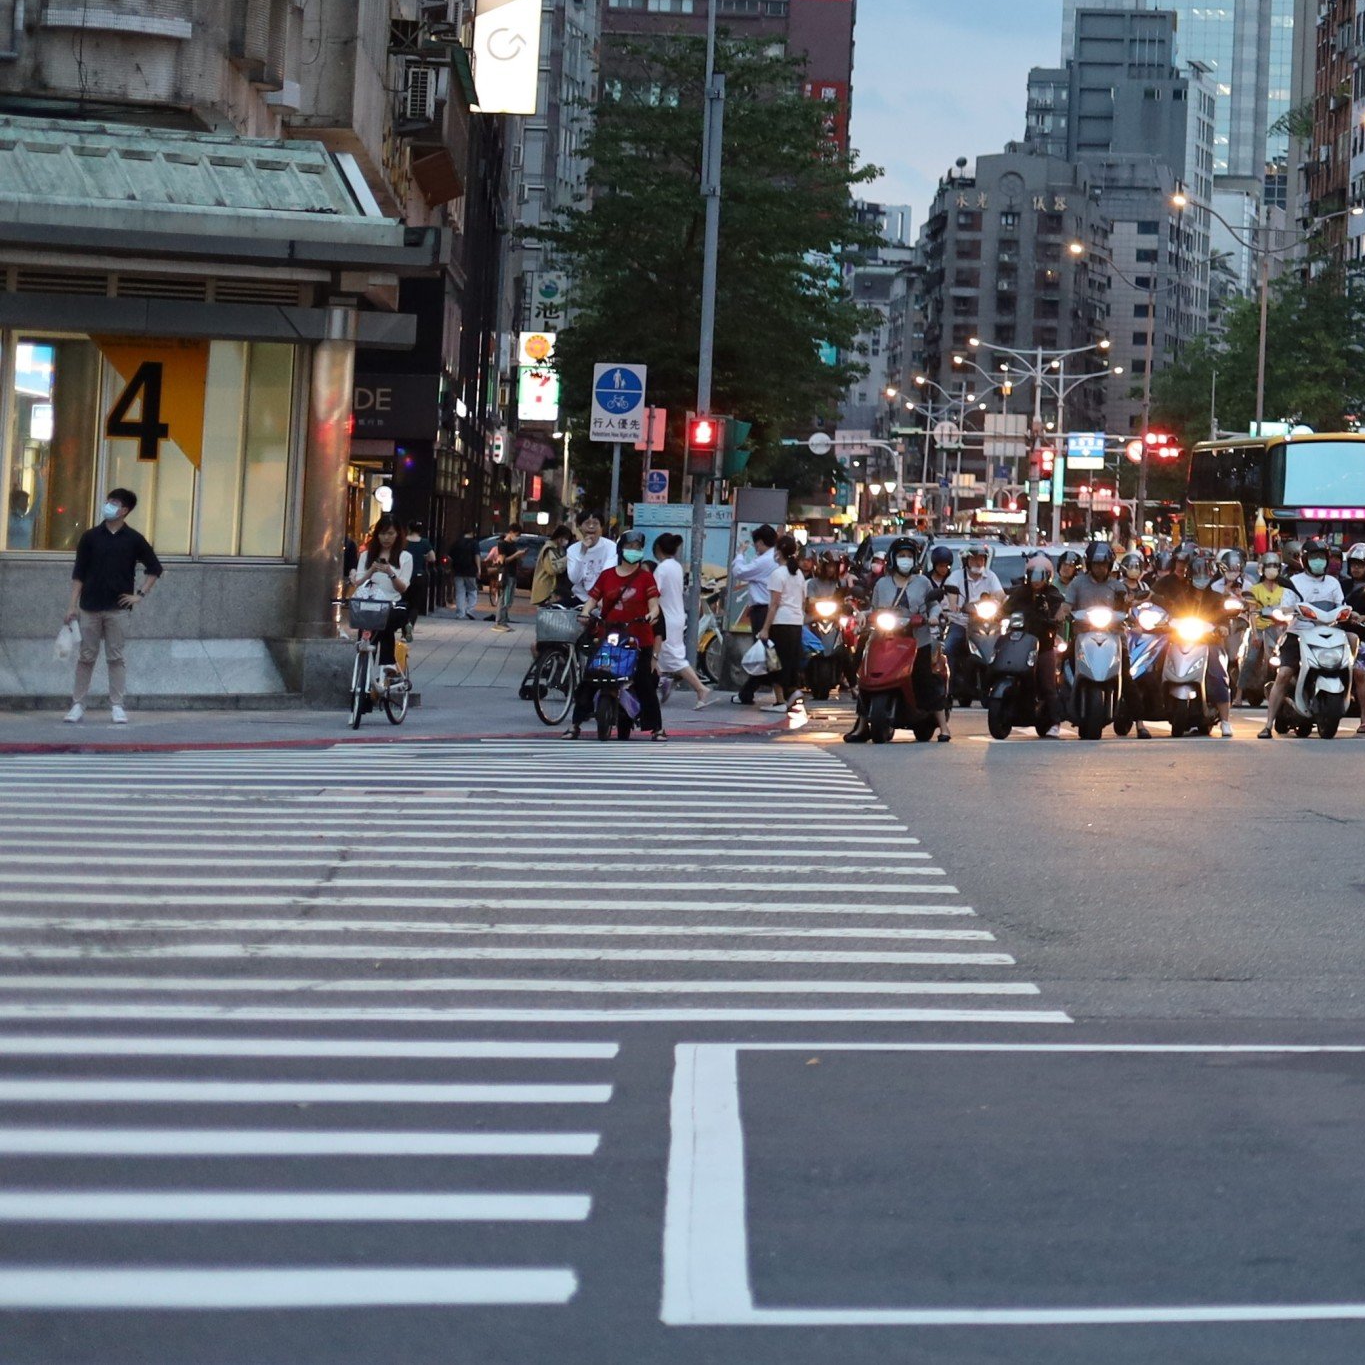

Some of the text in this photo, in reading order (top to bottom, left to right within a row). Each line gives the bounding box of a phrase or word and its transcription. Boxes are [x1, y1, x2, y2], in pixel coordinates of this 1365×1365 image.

[107, 362, 169, 459] 4
[593, 418, 641, 431] 行人優先
